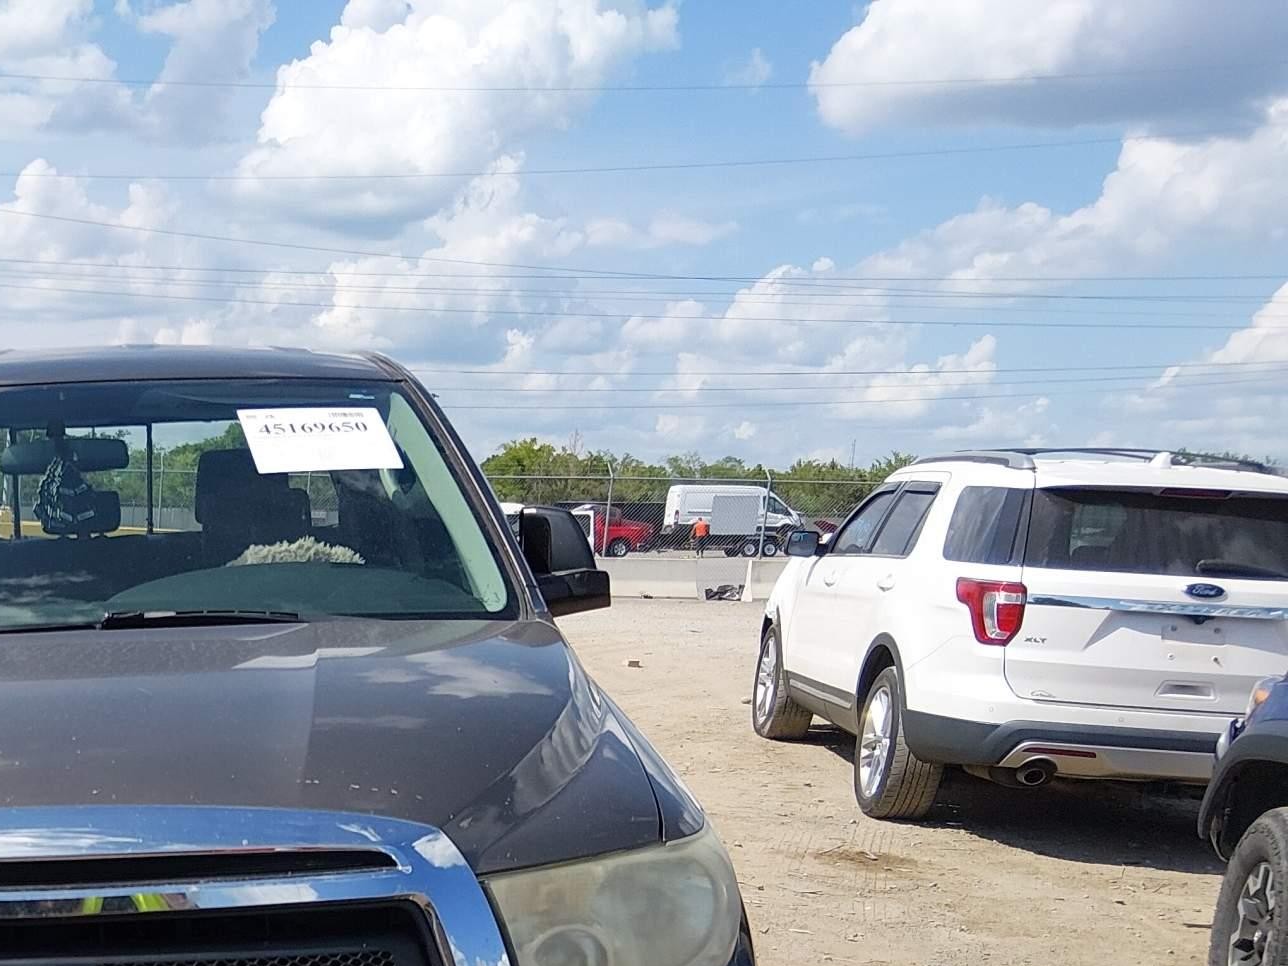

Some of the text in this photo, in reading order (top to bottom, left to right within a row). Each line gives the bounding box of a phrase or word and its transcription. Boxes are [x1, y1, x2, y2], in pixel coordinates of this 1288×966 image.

[259, 421, 368, 435] 45169650
[1191, 585, 1218, 596] Ford
[1024, 636, 1048, 644] XLT
